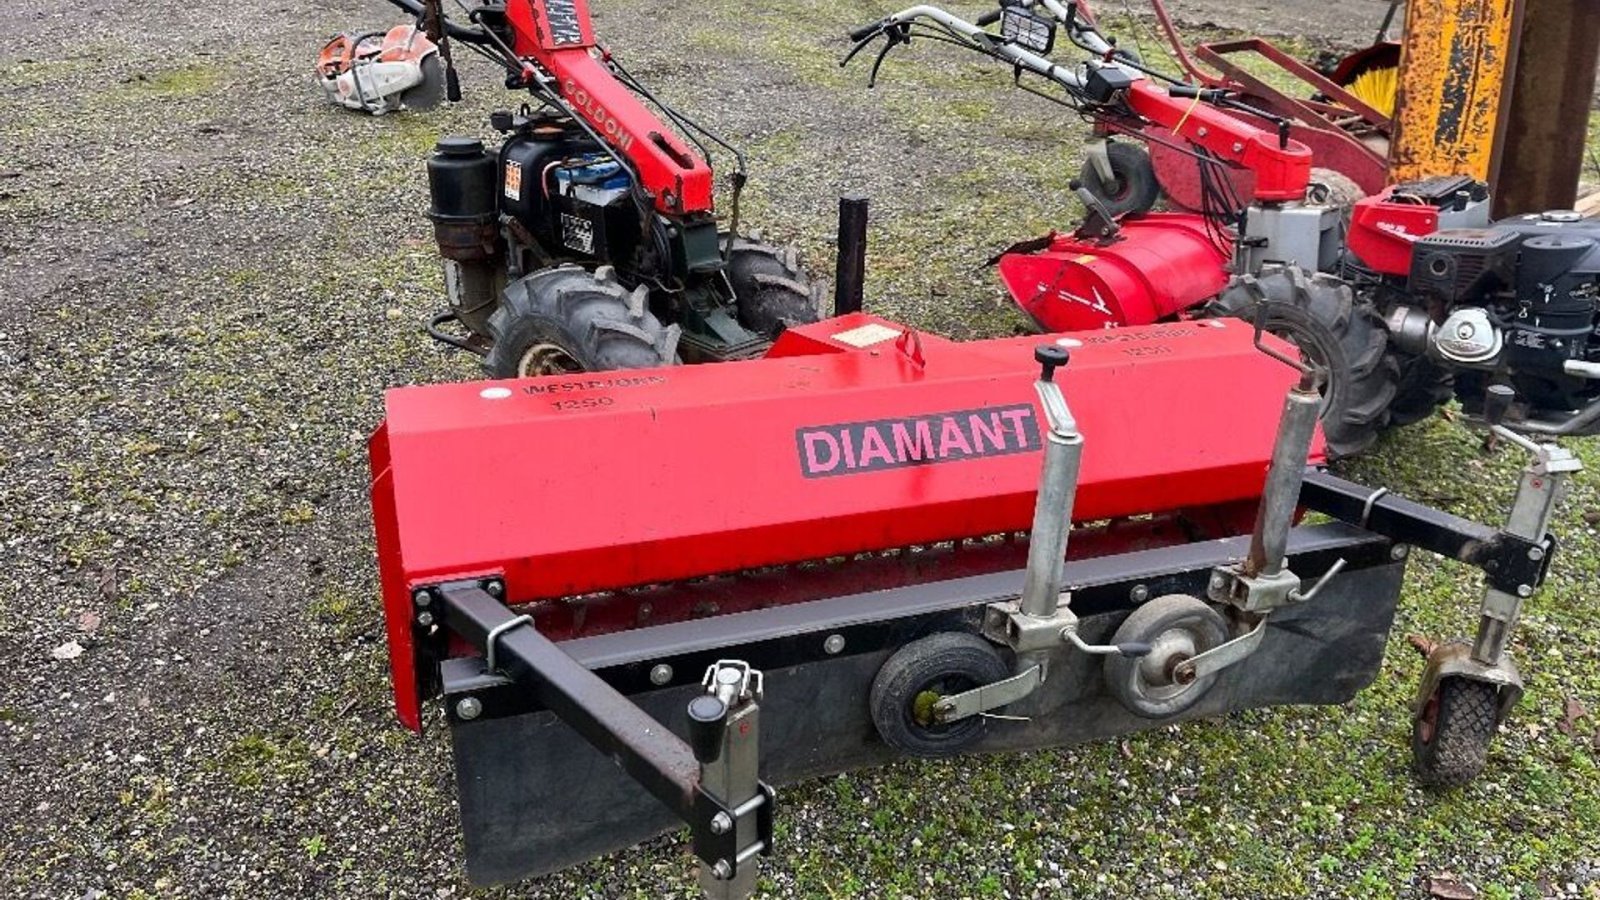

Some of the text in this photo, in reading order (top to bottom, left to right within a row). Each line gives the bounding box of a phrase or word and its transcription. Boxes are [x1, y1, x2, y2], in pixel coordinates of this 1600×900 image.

[565, 79, 634, 152] GOLDONI
[551, 396, 614, 410] 1250
[803, 408, 1031, 473] DIAMANT
